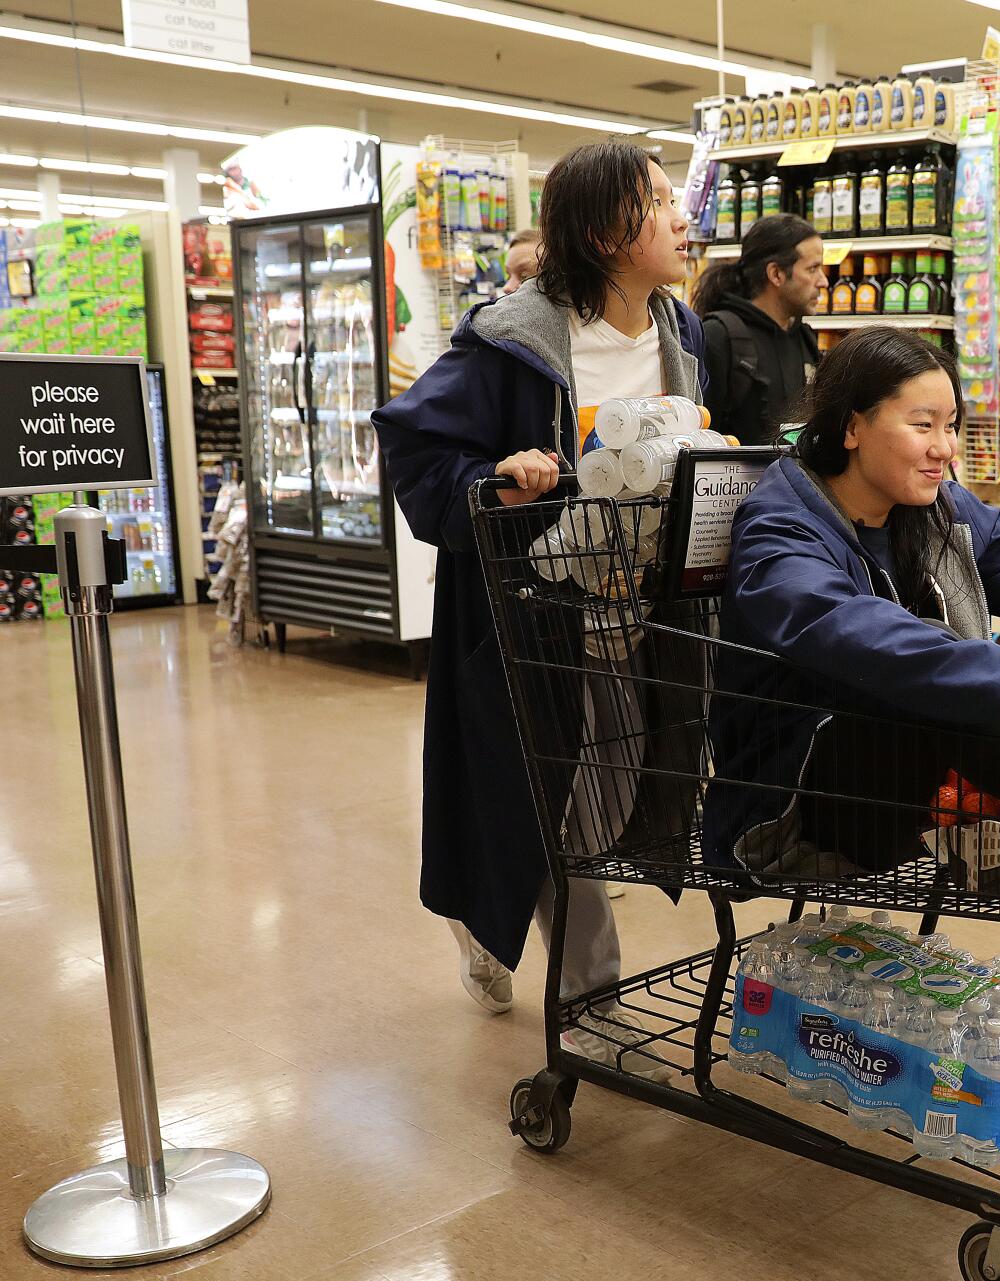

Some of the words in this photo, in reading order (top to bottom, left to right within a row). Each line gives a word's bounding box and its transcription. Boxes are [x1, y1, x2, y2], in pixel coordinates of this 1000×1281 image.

[31, 381, 100, 408] please
[20, 413, 65, 435] wait
[69, 413, 116, 434] here
[18, 445, 48, 467] for
[51, 444, 125, 472] privacy
[724, 465, 741, 474] THE
[712, 499, 744, 508] CENTE
[809, 1030, 887, 1073] refreshe
[810, 1048, 841, 1062] PURIFIED
[860, 1070, 882, 1086] WATER
